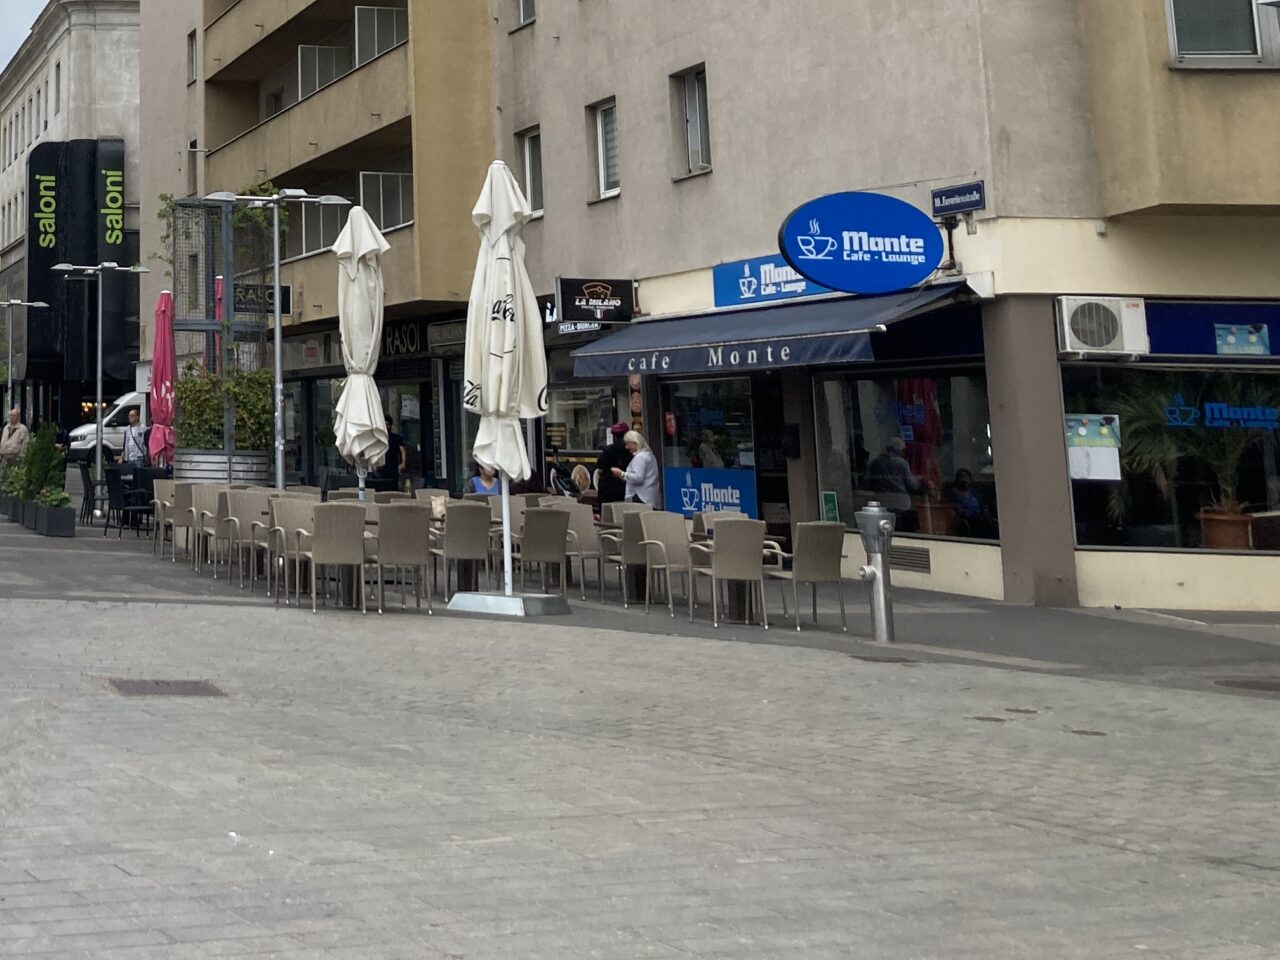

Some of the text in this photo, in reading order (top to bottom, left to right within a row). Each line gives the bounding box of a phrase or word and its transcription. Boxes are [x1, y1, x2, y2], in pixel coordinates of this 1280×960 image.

[34, 174, 56, 249] saloni
[100, 169, 123, 245] saloni
[843, 250, 871, 261] Cafe
[882, 251, 926, 265] Lounge
[589, 298, 621, 306] MILANO
[386, 321, 420, 355] RASOI
[628, 346, 791, 370] cafe Monte
